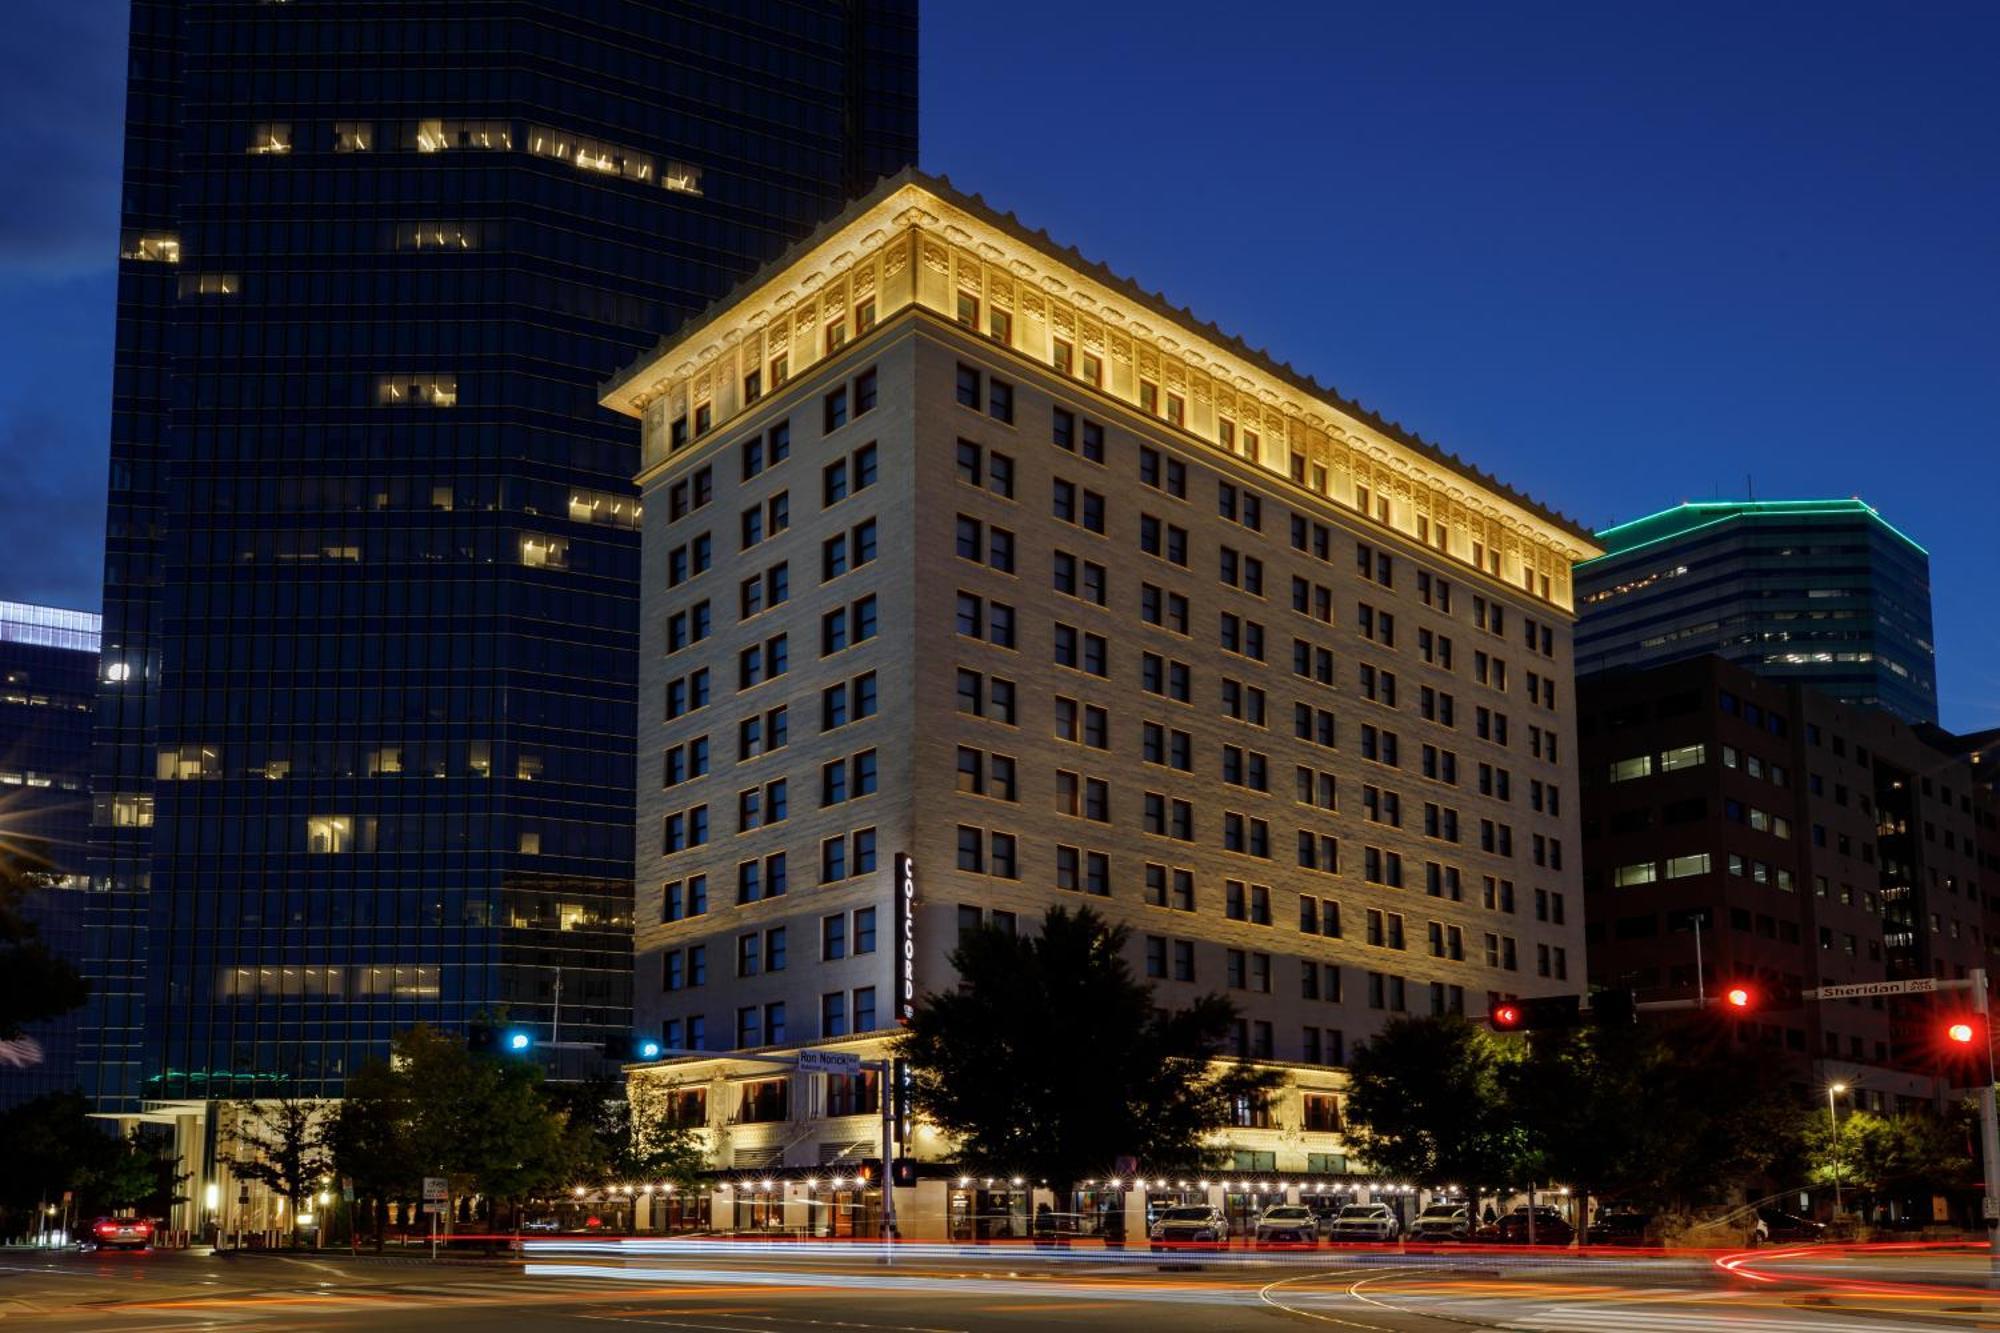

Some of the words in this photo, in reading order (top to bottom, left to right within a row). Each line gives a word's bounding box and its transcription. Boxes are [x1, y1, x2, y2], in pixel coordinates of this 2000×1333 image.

[904, 857, 914, 1000] COLCORD
[1823, 984, 1900, 997] Sheridan
[800, 1051, 817, 1063] Ron
[820, 1053, 847, 1065] Norick
